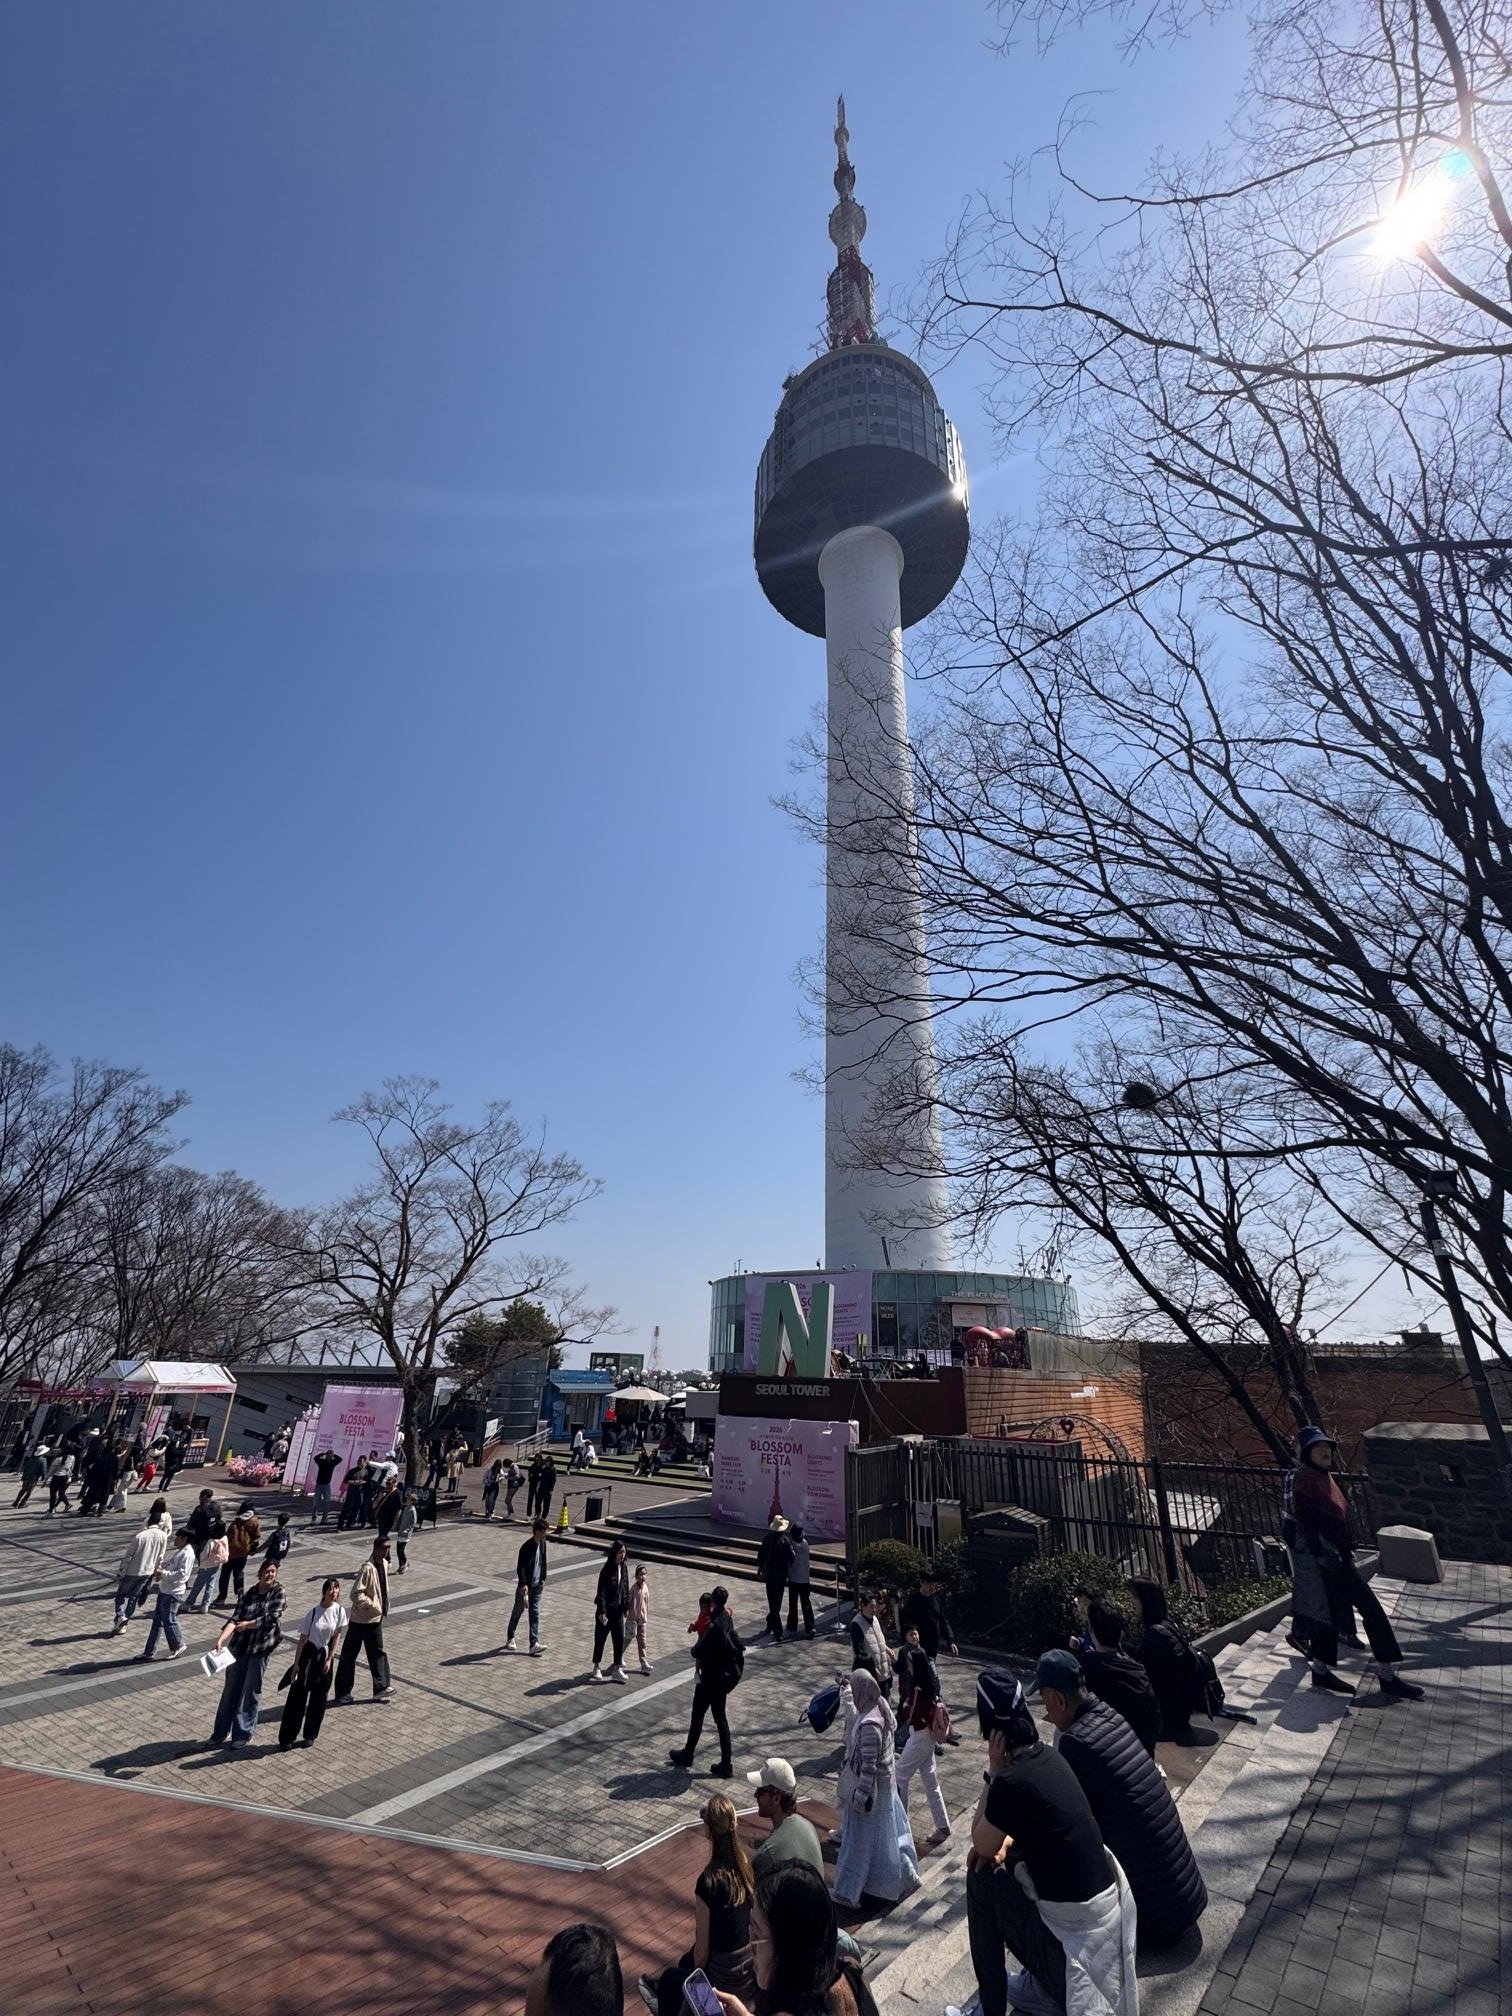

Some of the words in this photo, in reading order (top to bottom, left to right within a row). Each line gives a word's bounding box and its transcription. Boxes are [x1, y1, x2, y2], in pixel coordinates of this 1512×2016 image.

[756, 1282, 834, 1378] N
[755, 1383, 790, 1396] SEOUL
[790, 1384, 831, 1397] TOWER
[339, 1414, 375, 1427] BLOSSOM
[344, 1426, 365, 1438] FESTA
[750, 1440, 803, 1455] BLOSSOM
[760, 1453, 792, 1467] FESTA
